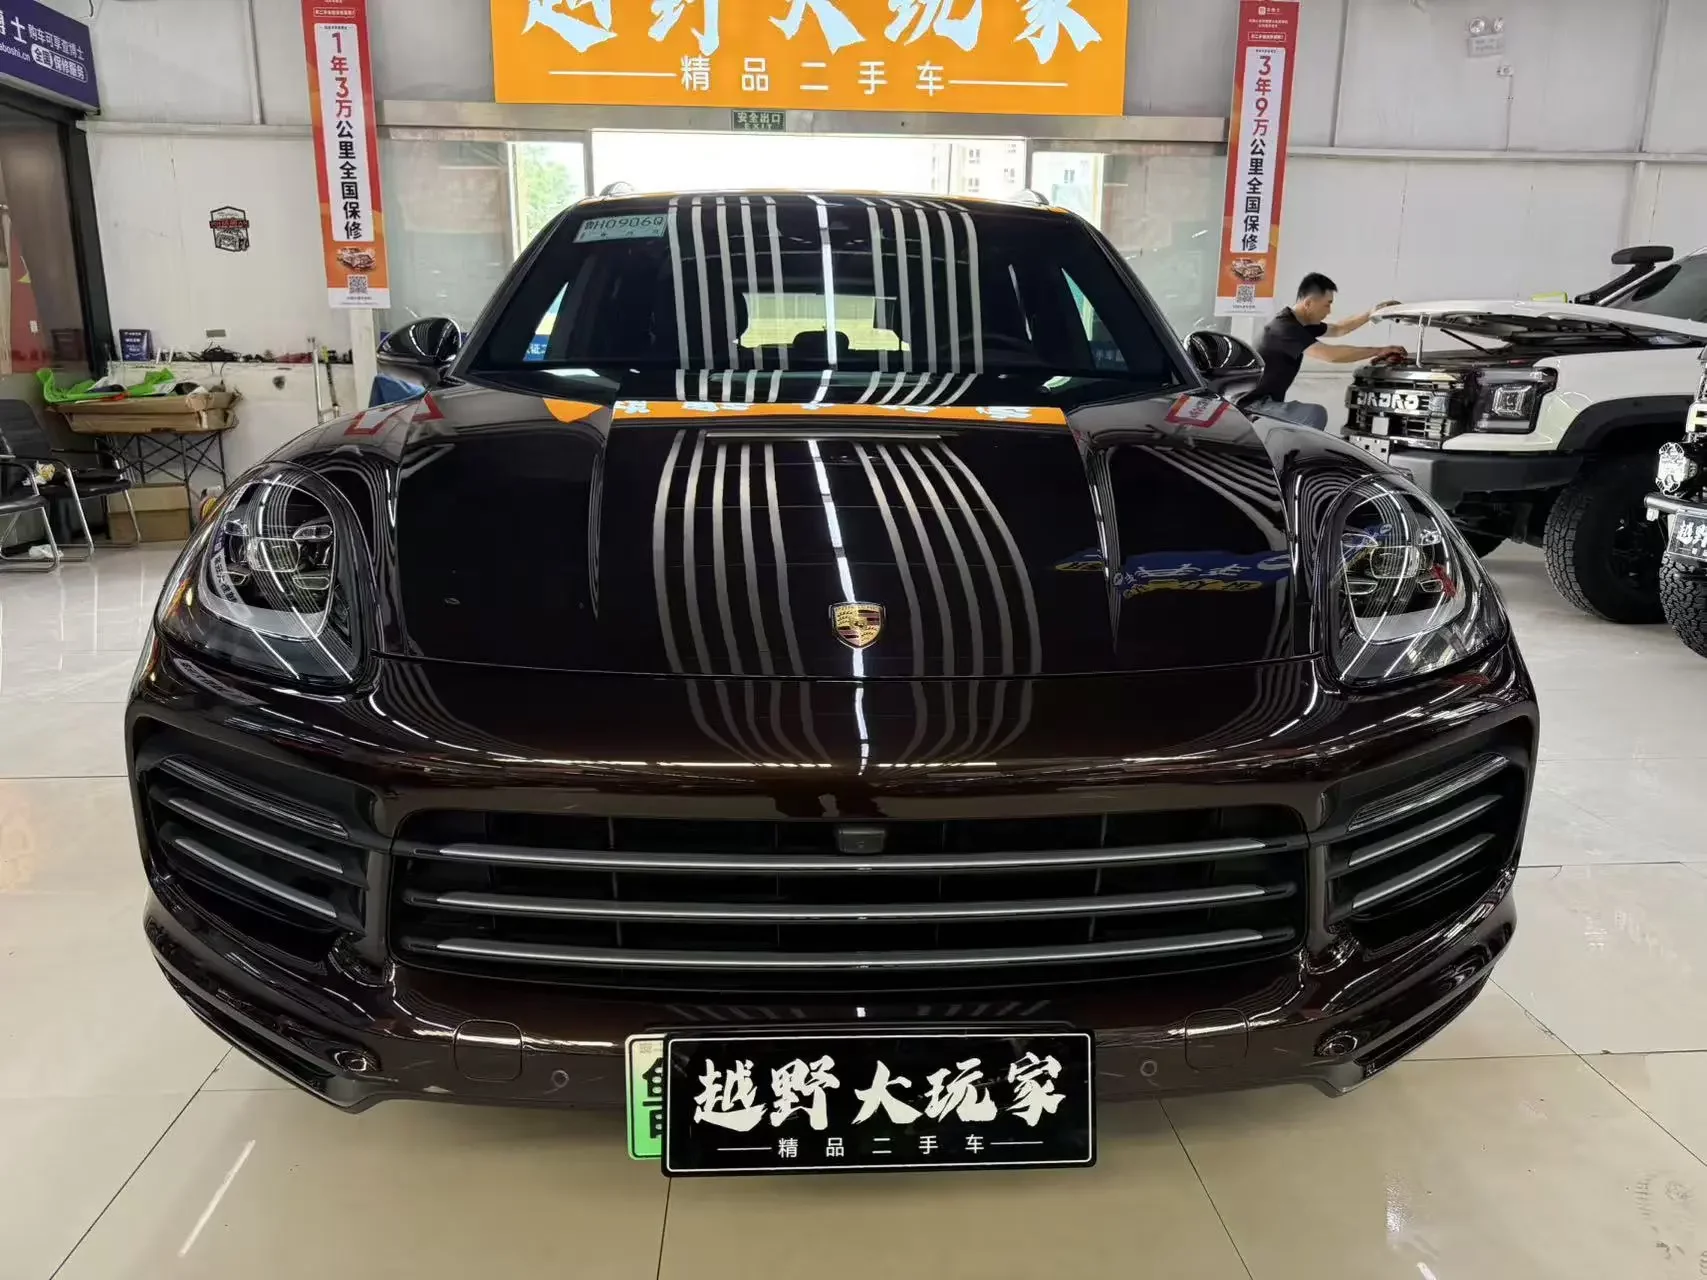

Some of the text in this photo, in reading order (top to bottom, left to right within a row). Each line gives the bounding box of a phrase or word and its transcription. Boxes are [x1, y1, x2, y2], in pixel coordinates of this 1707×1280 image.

[34, 47, 85, 80] 全国保修服务
[680, 56, 946, 97] 精品二手车
[330, 32, 363, 240] 1年3万公里全国保修
[737, 112, 781, 123] 安全出口
[1241, 55, 1272, 251] 3年9万公里全国保修
[693, 1051, 1067, 1132] 越野大玩家
[778, 1134, 985, 1158] 精品二手车
